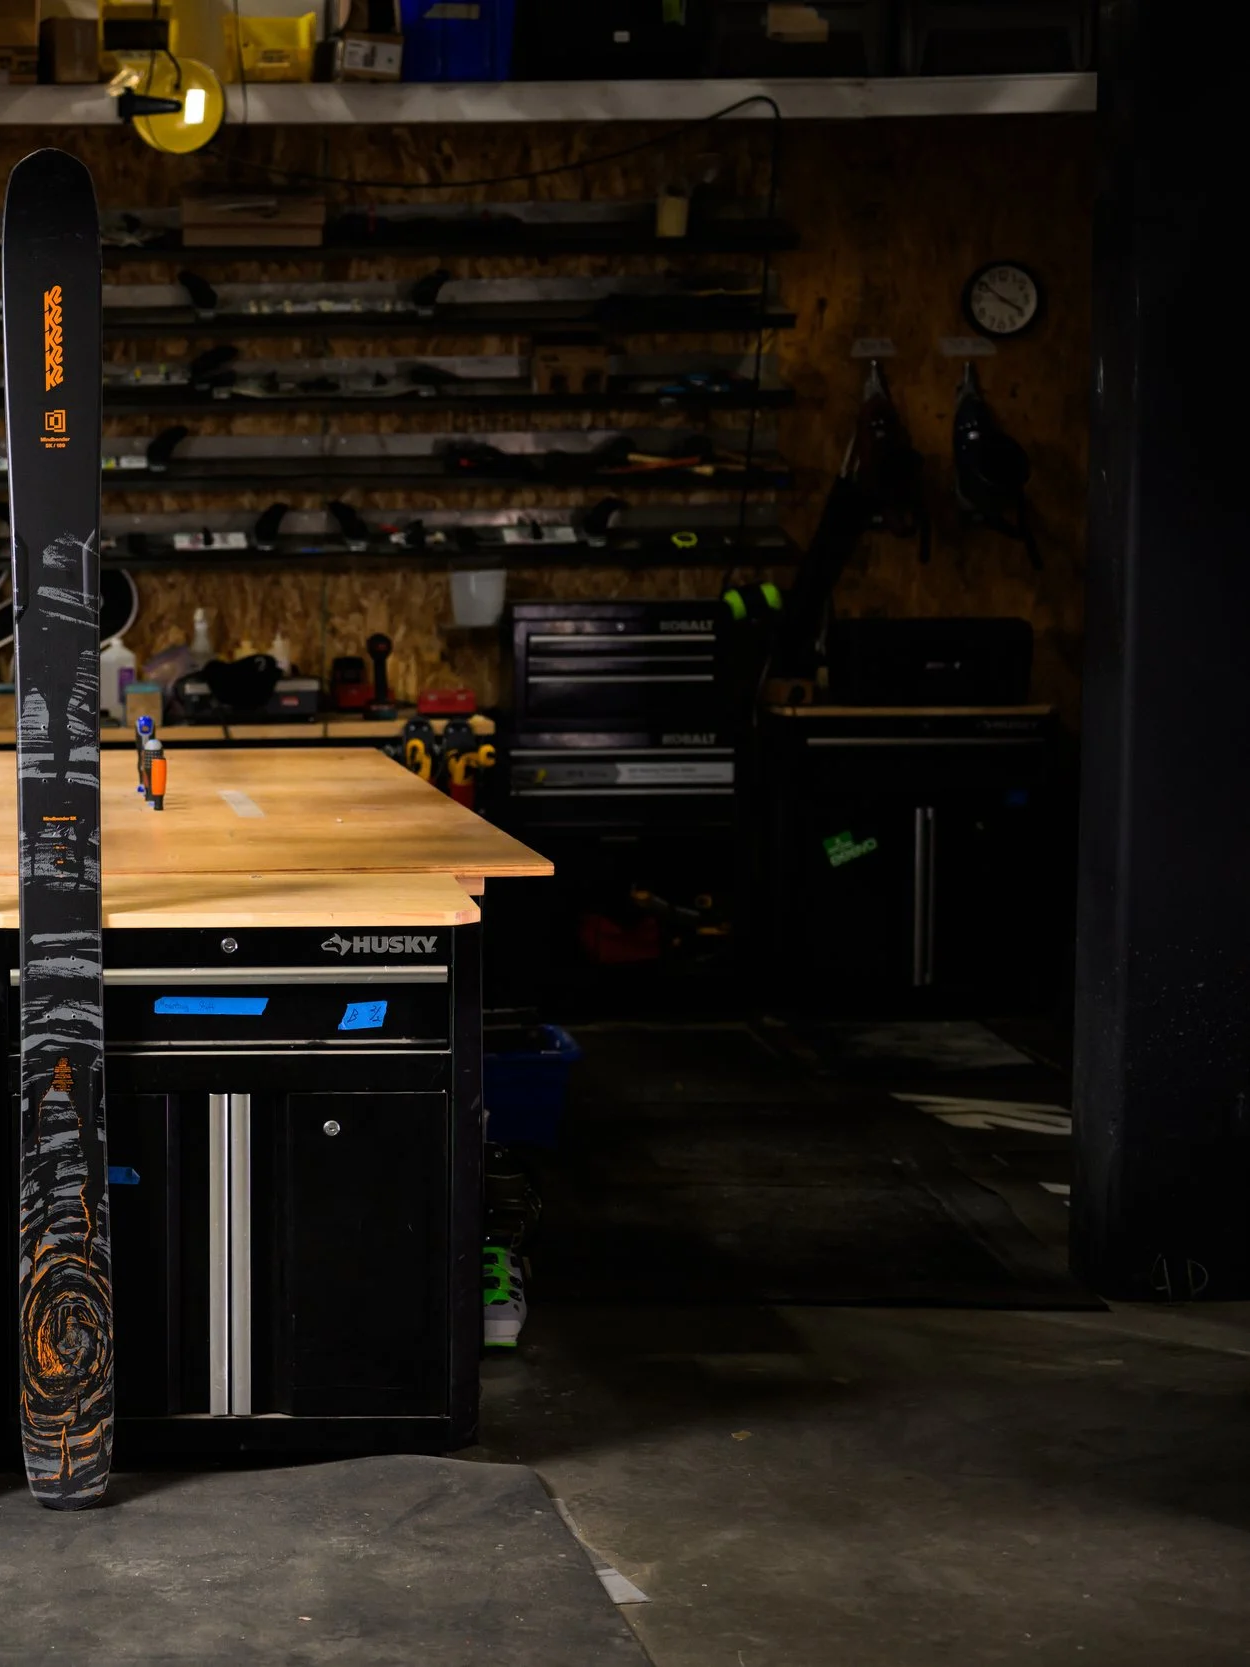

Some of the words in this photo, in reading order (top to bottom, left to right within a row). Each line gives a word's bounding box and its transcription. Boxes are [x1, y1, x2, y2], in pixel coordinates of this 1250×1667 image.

[659, 619, 715, 632] KOBALT
[661, 732, 717, 746] KOBALT
[352, 936, 438, 953] HUSKY
